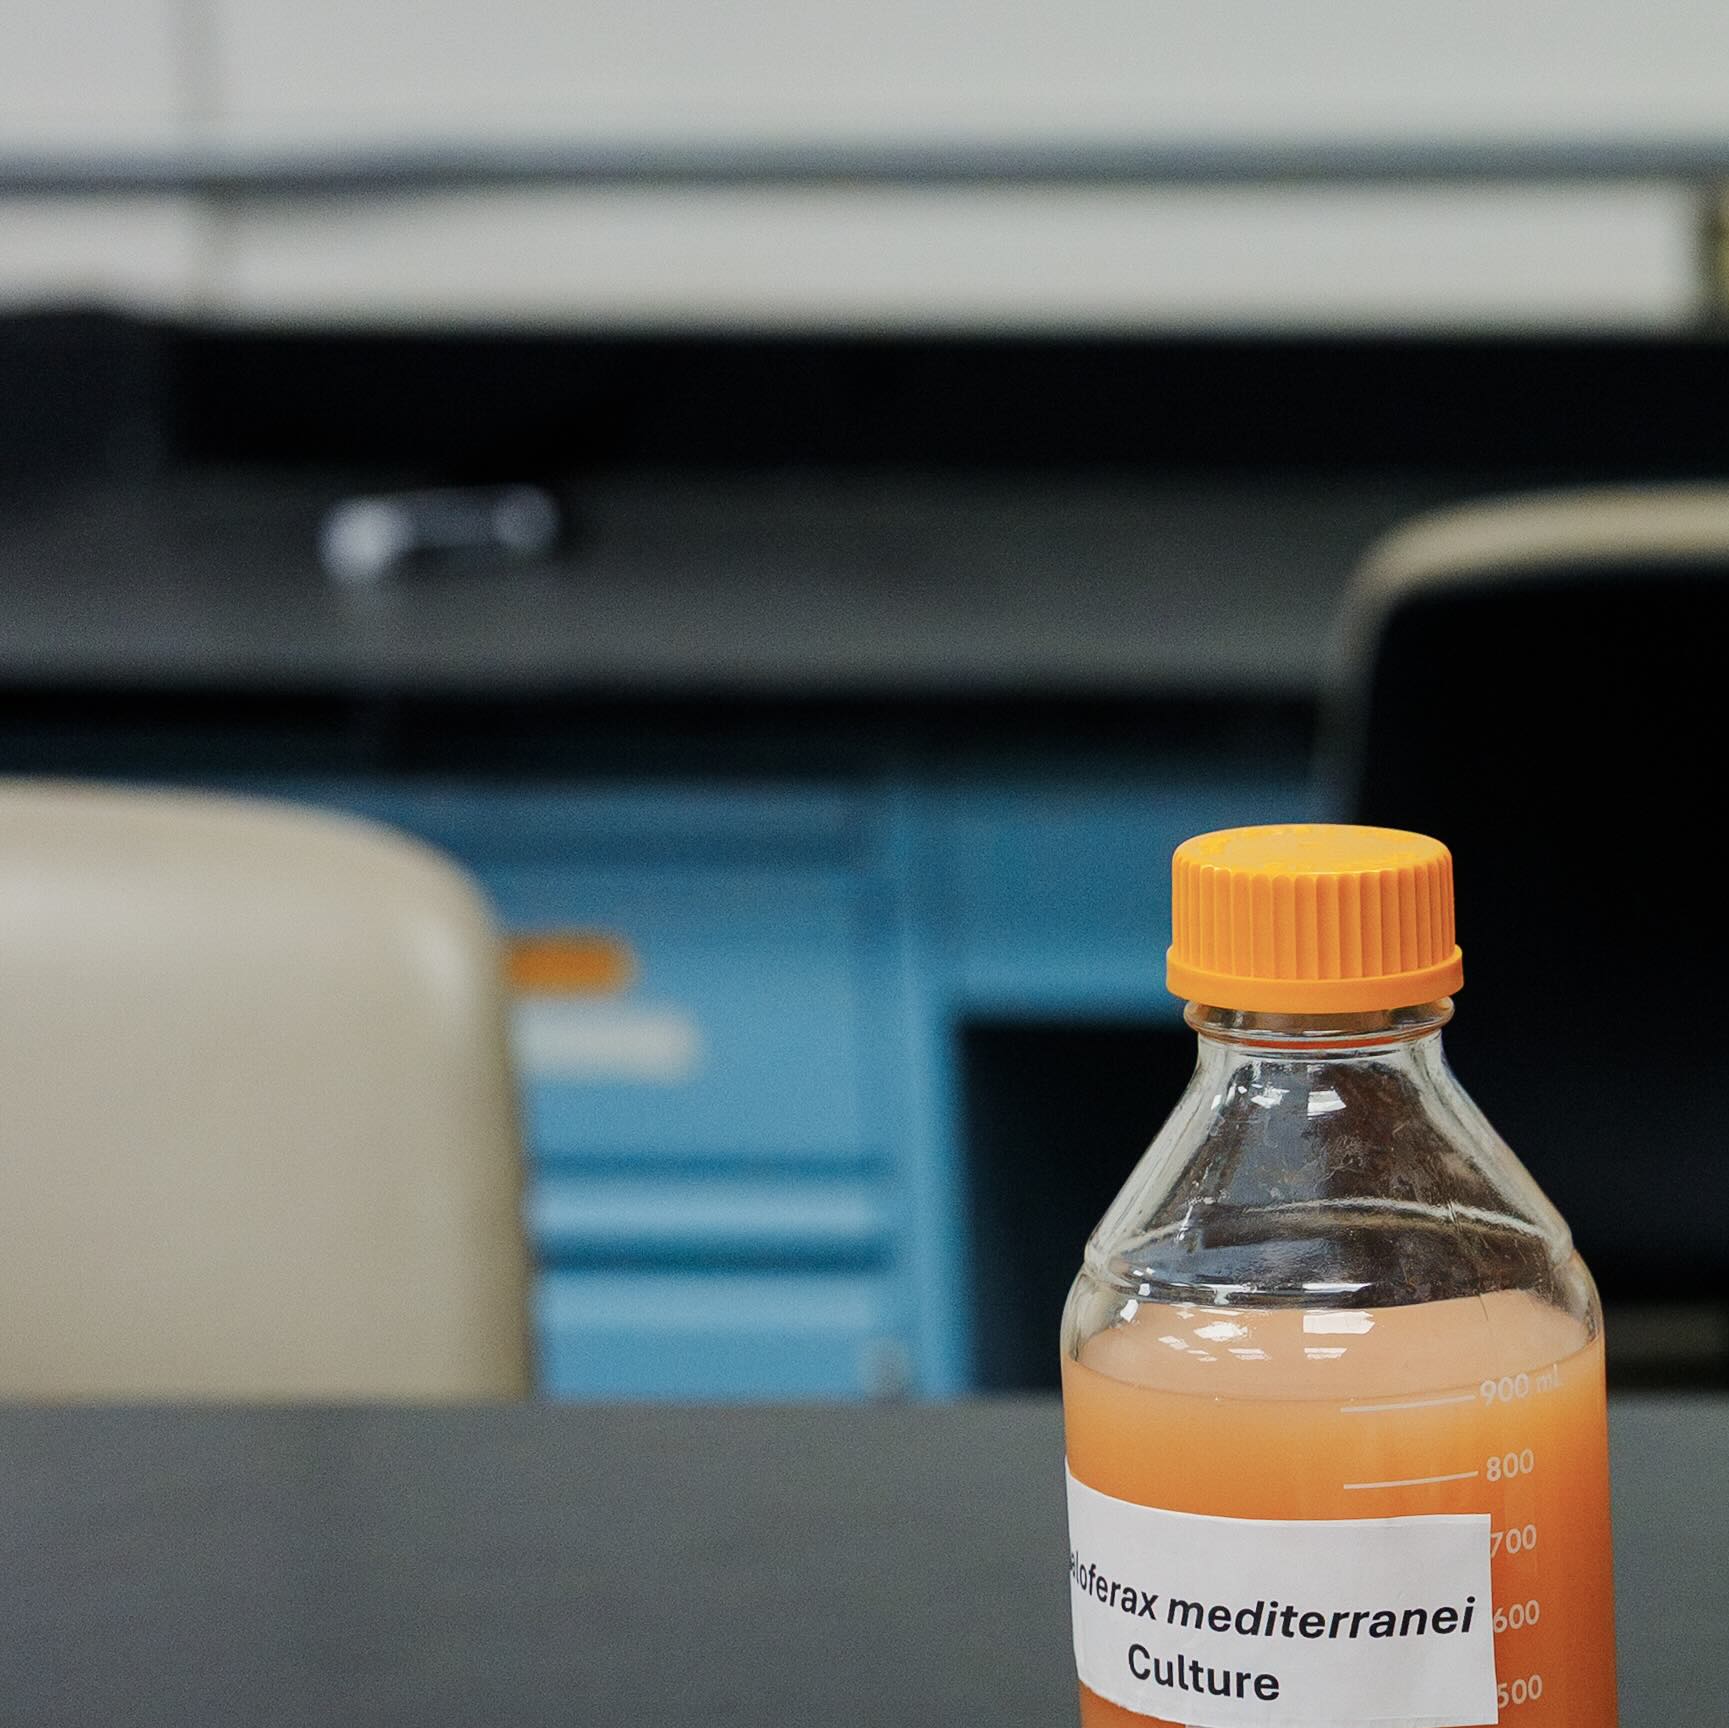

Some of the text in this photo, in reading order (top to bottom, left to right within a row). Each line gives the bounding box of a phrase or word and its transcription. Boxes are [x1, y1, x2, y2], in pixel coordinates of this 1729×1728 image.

[1480, 1373, 1529, 1407] 900
[1486, 1449, 1534, 1482] 800
[1491, 1524, 1537, 1559] 700
[1167, 1596, 1476, 1639] mediterranei
[1493, 1600, 1540, 1633] 600
[1128, 1643, 1279, 1701] Culture
[1497, 1674, 1543, 1709] 500
